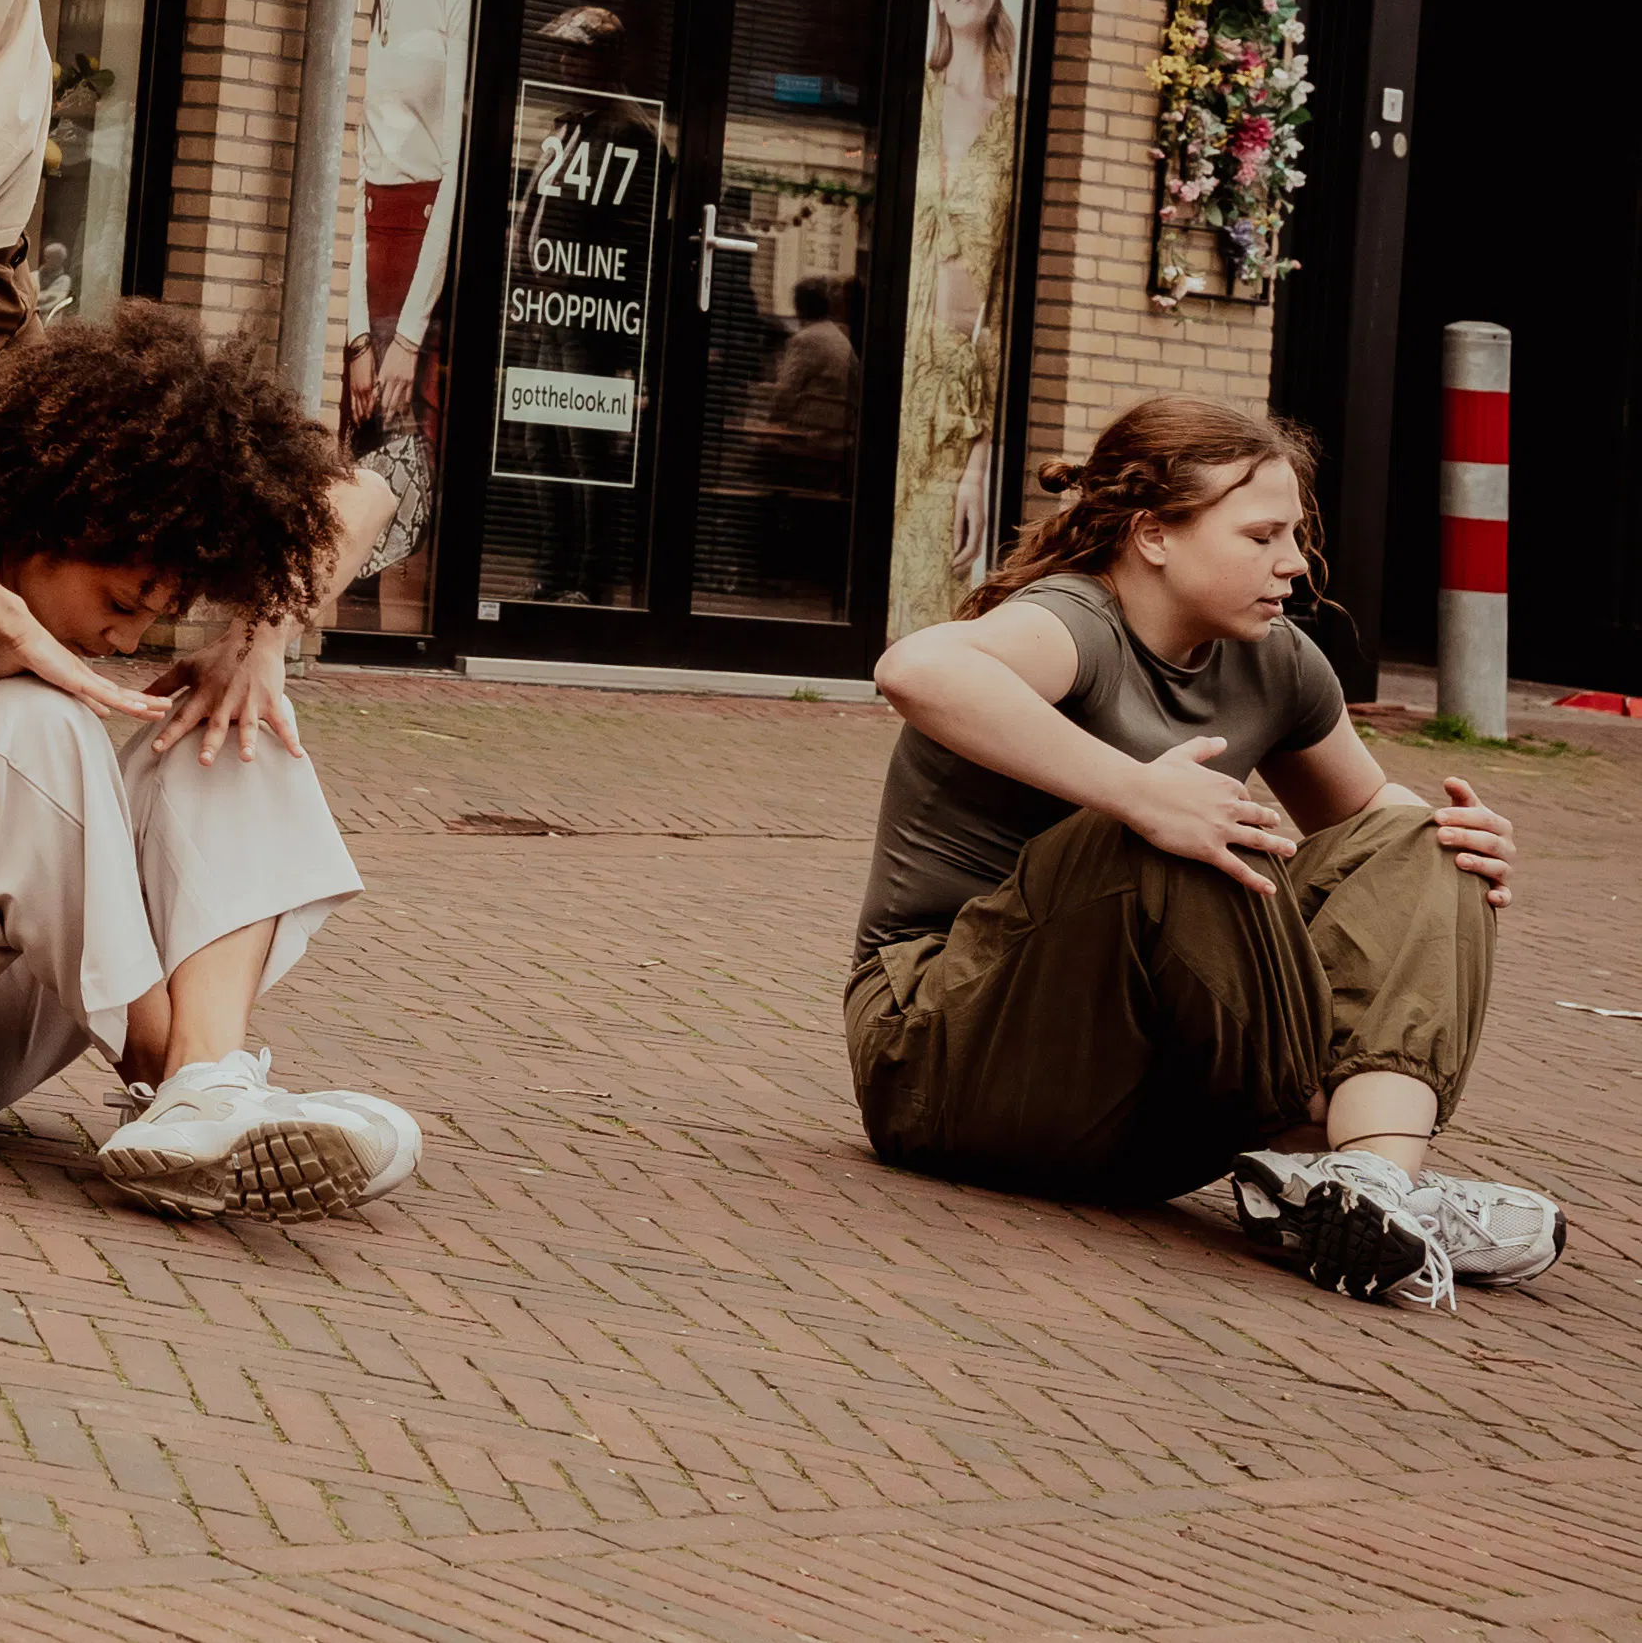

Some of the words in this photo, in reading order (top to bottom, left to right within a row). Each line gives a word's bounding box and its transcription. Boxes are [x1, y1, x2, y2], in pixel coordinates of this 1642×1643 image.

[536, 135, 640, 206] 24/7
[532, 237, 628, 282] ONLINE
[510, 287, 642, 337] SHOPPING
[511, 383, 627, 416] gotthelook.nl
